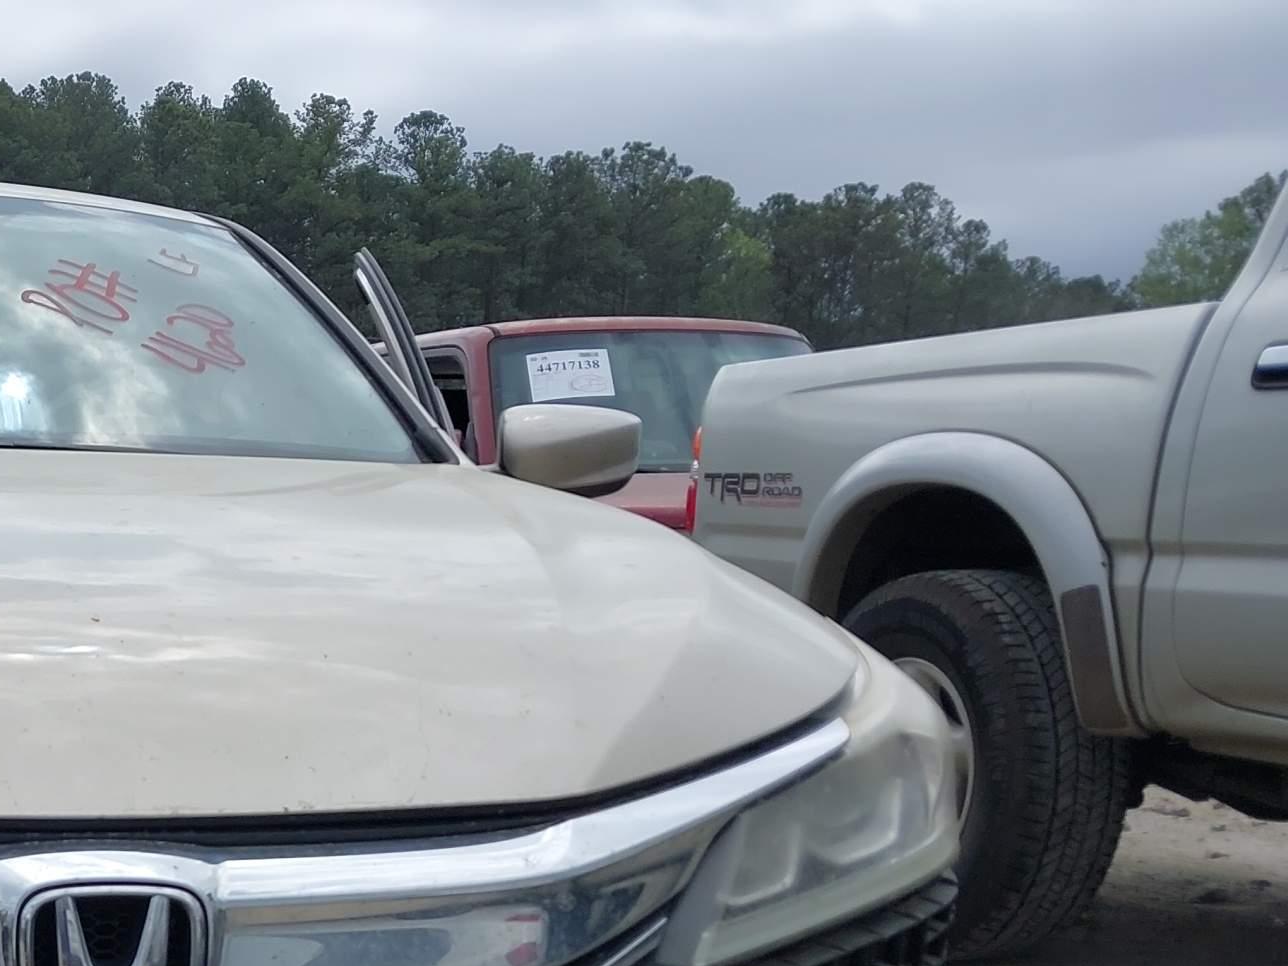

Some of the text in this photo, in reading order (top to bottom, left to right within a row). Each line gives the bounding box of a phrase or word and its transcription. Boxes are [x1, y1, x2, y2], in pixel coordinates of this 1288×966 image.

[537, 359, 600, 373] 44717138
[763, 473, 794, 484] OFF
[704, 473, 760, 503] TRD
[762, 486, 802, 496] ROAD
